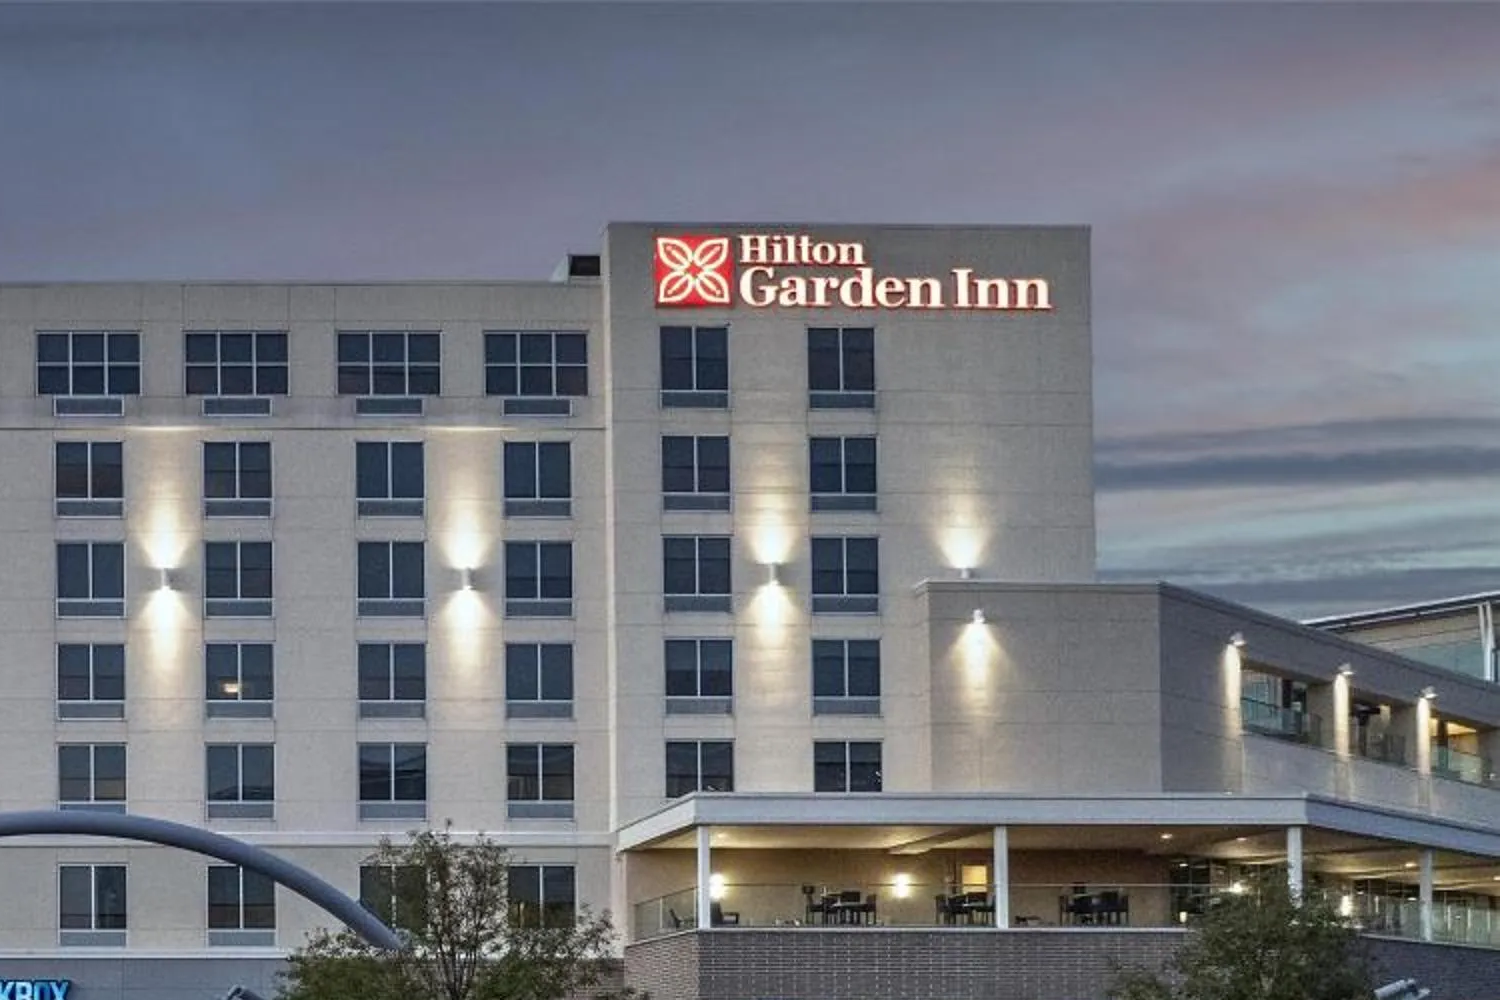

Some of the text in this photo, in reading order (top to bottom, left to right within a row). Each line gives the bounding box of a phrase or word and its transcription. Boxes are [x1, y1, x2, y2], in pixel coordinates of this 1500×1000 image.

[739, 234, 866, 265] Hilton
[739, 266, 1053, 310] Garden Inn
